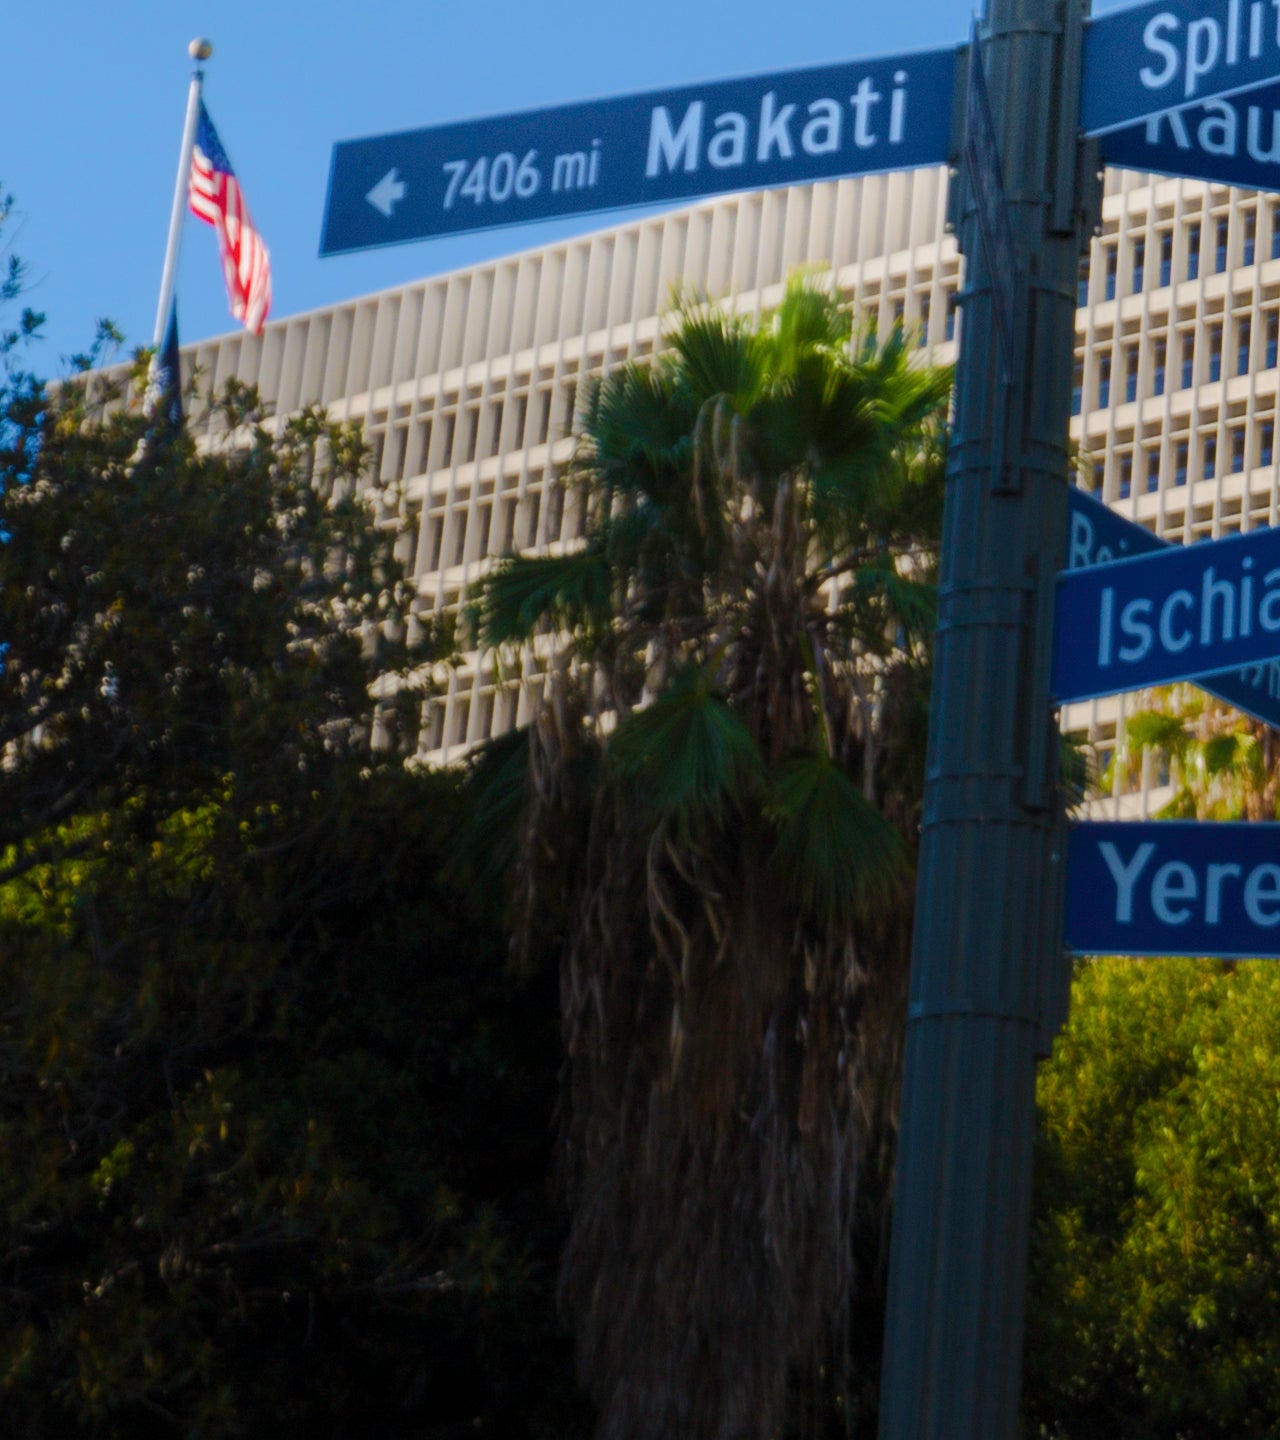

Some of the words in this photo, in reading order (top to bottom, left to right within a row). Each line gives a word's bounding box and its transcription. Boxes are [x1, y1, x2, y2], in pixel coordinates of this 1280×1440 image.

[441, 148, 542, 210] 7406
[551, 137, 602, 194] mi
[646, 69, 908, 179] Makati
